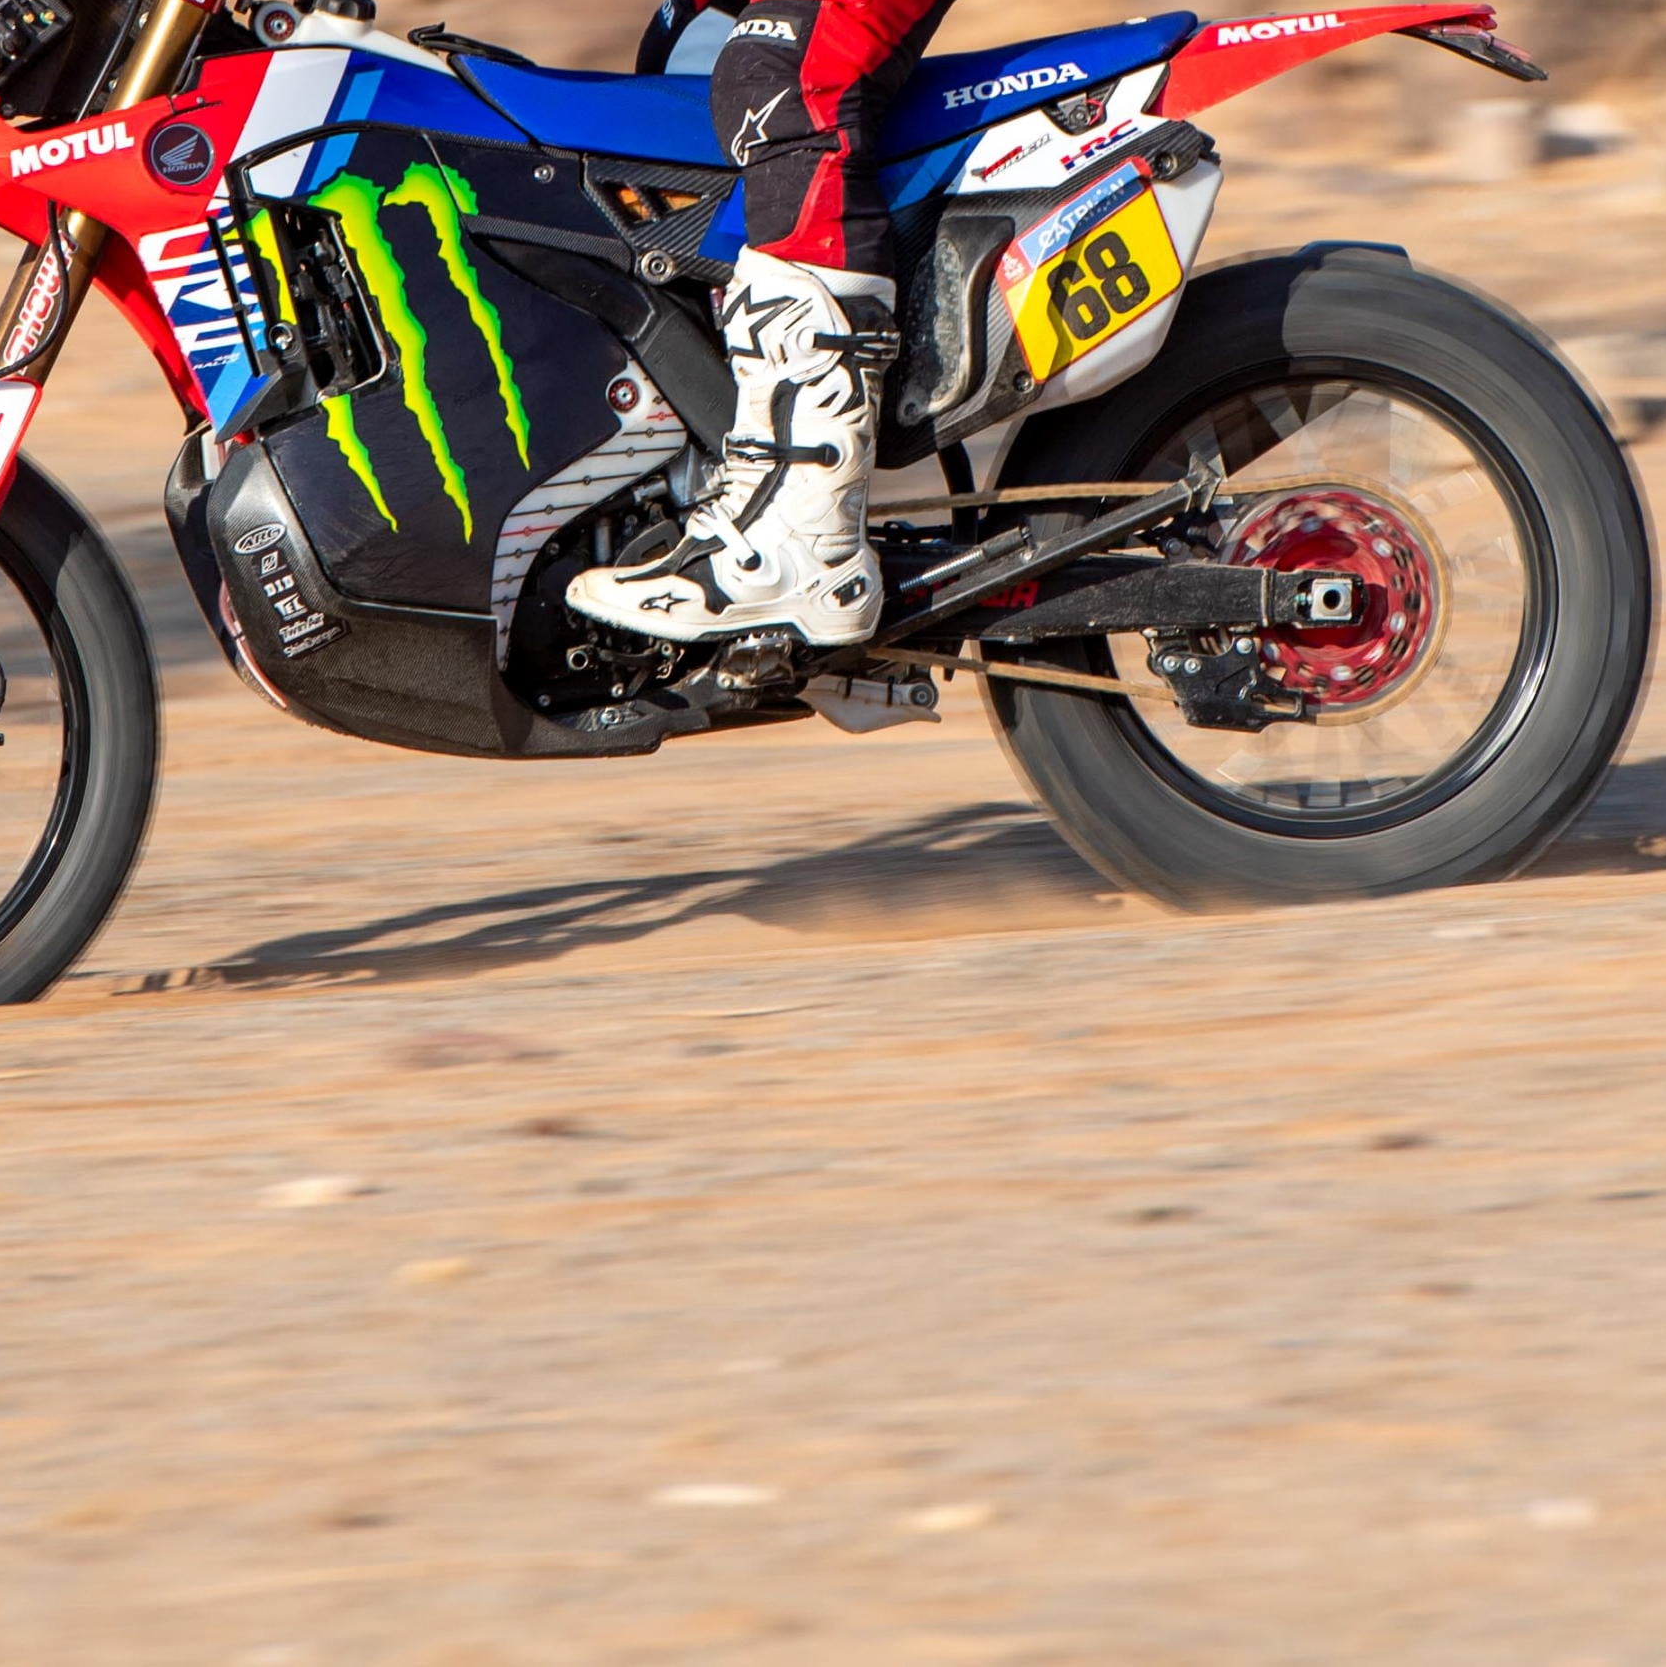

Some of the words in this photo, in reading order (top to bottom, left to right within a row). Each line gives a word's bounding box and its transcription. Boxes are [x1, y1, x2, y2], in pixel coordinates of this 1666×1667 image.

[1217, 14, 1345, 46] MOTUL
[942, 62, 1088, 110] HONDA
[12, 123, 135, 178] MOTUL
[162, 161, 206, 174] HONDA
[1060, 119, 1138, 171] HRC
[1047, 230, 1151, 341] 68
[240, 526, 281, 551] ARC
